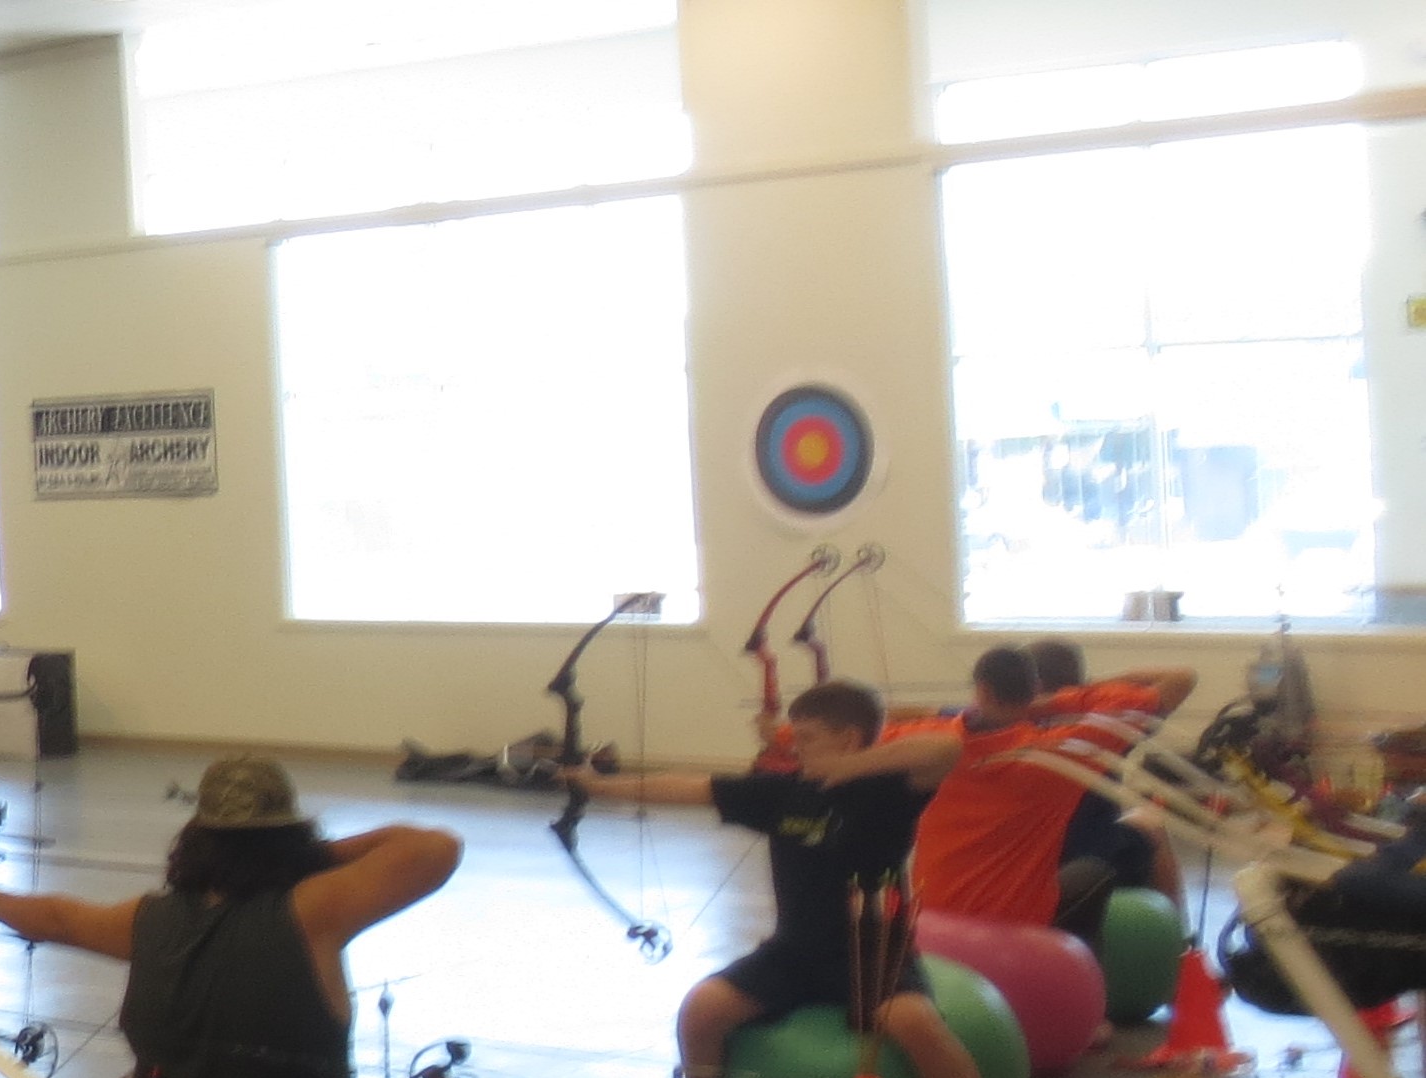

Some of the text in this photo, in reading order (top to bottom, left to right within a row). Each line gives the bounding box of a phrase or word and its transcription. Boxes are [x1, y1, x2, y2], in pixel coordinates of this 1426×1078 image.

[40, 399, 210, 436] ARCHERY EXCELLENCE
[37, 435, 211, 468] INDOOR ARCHERY
